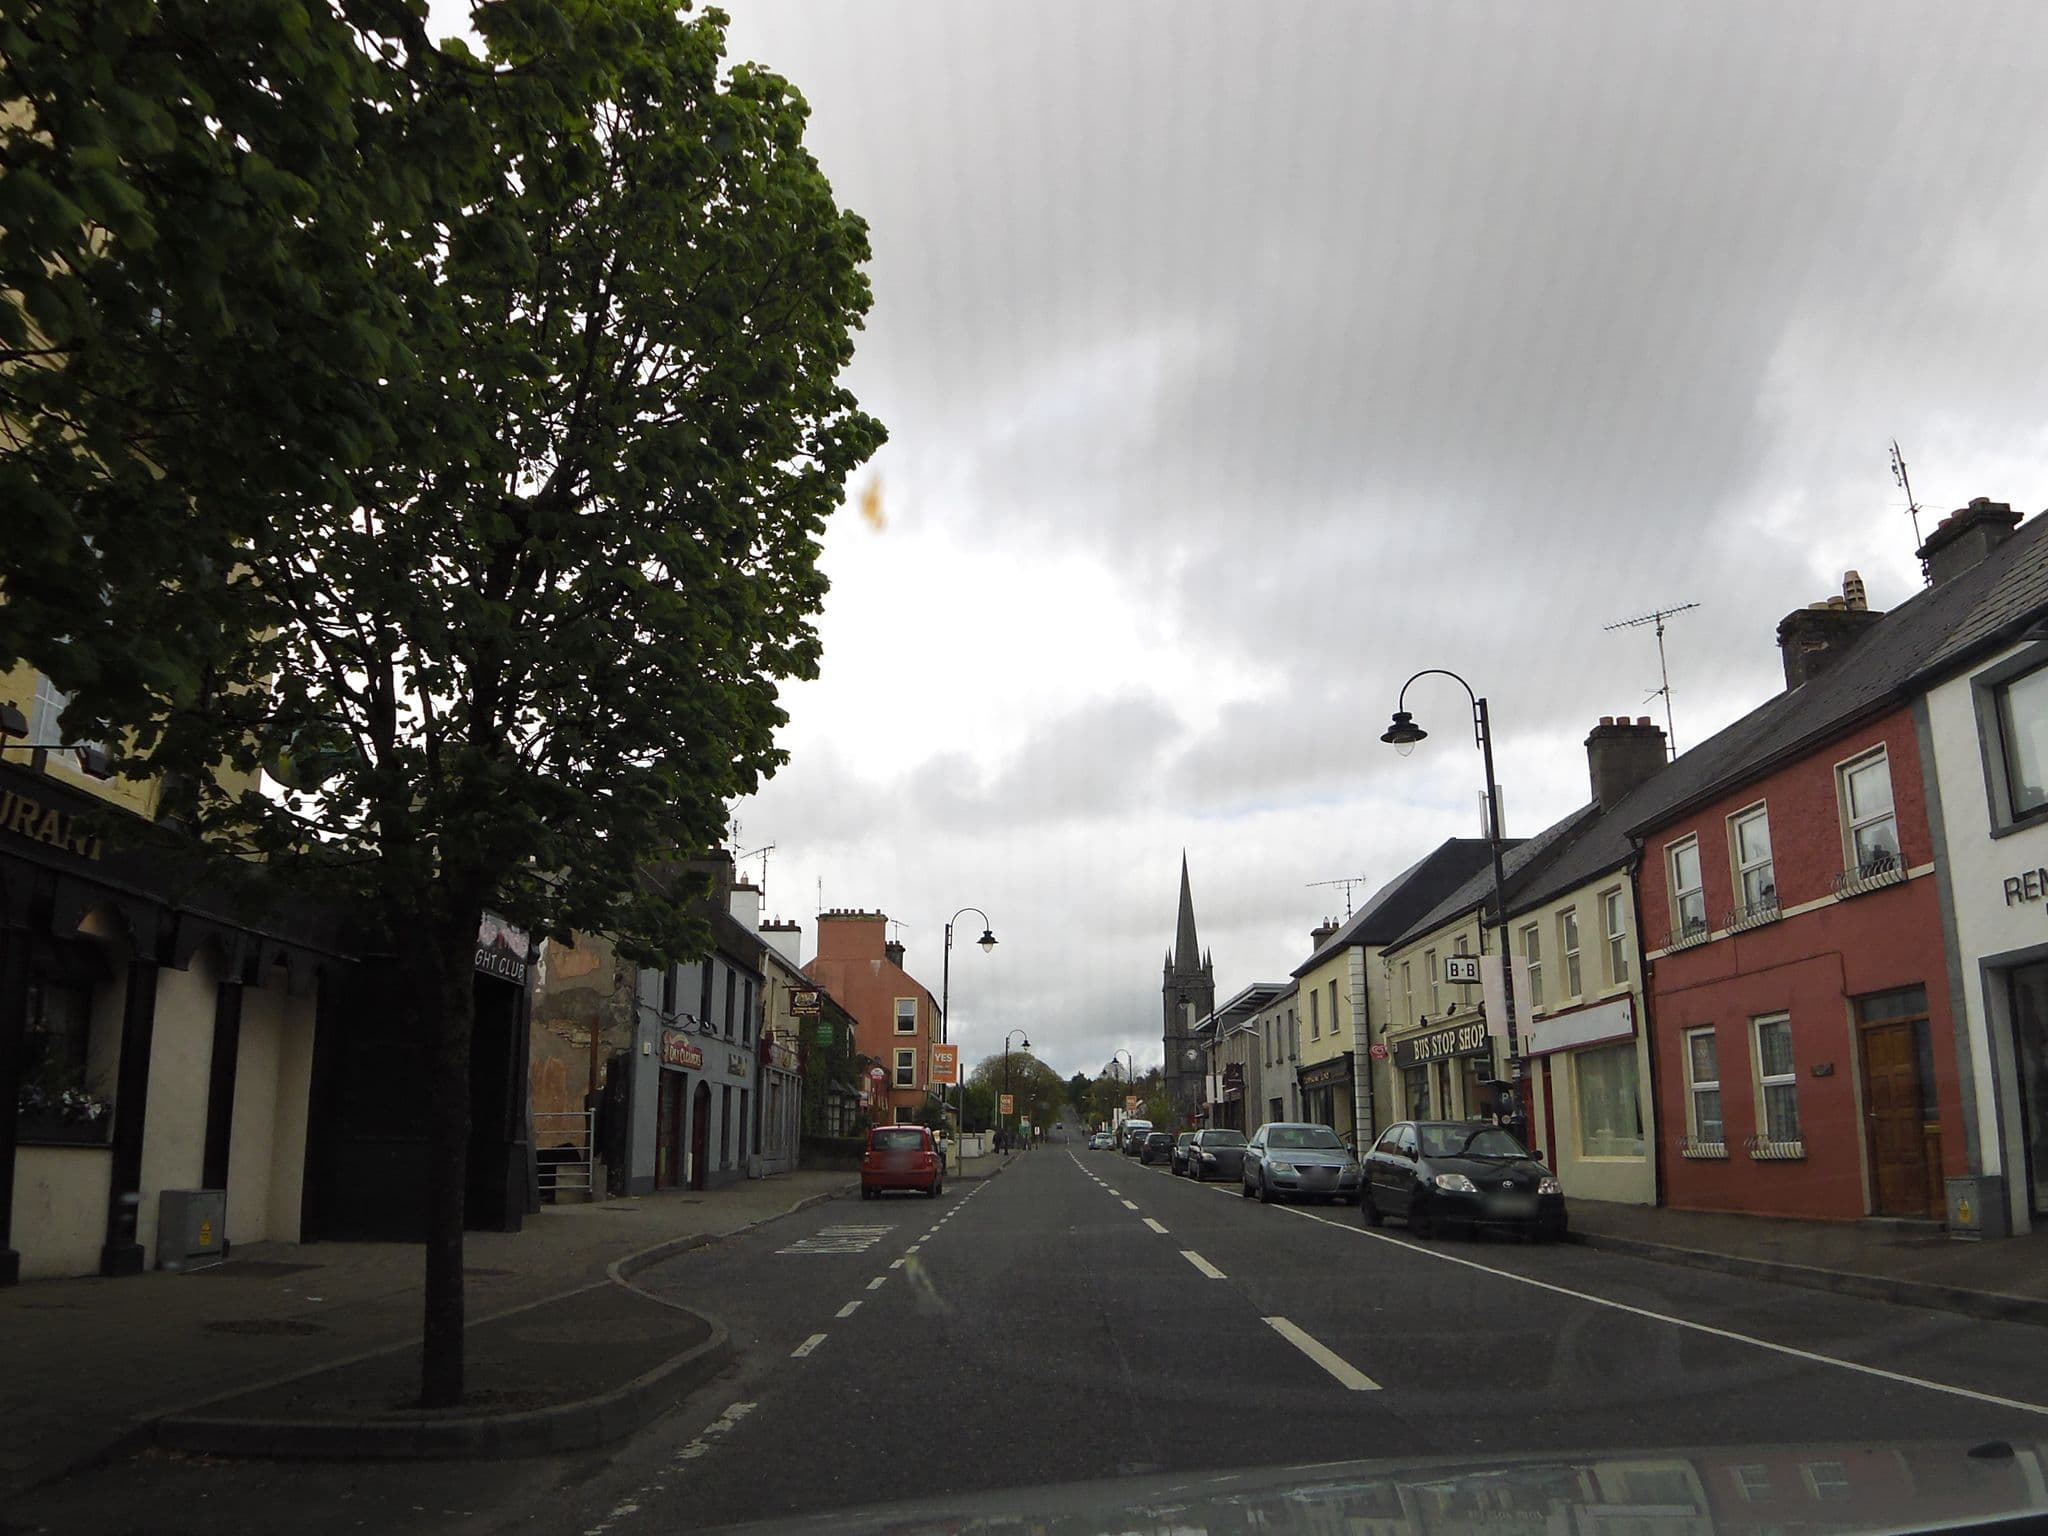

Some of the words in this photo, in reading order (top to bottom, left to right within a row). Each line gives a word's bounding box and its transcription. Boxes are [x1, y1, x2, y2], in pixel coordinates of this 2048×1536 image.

[498, 957, 525, 978] CLUB
[1413, 1036, 1430, 1060] BUS
[1432, 1031, 1456, 1056] STOP
[1458, 1023, 1485, 1051] SHOP
[934, 1053, 953, 1062] YES
